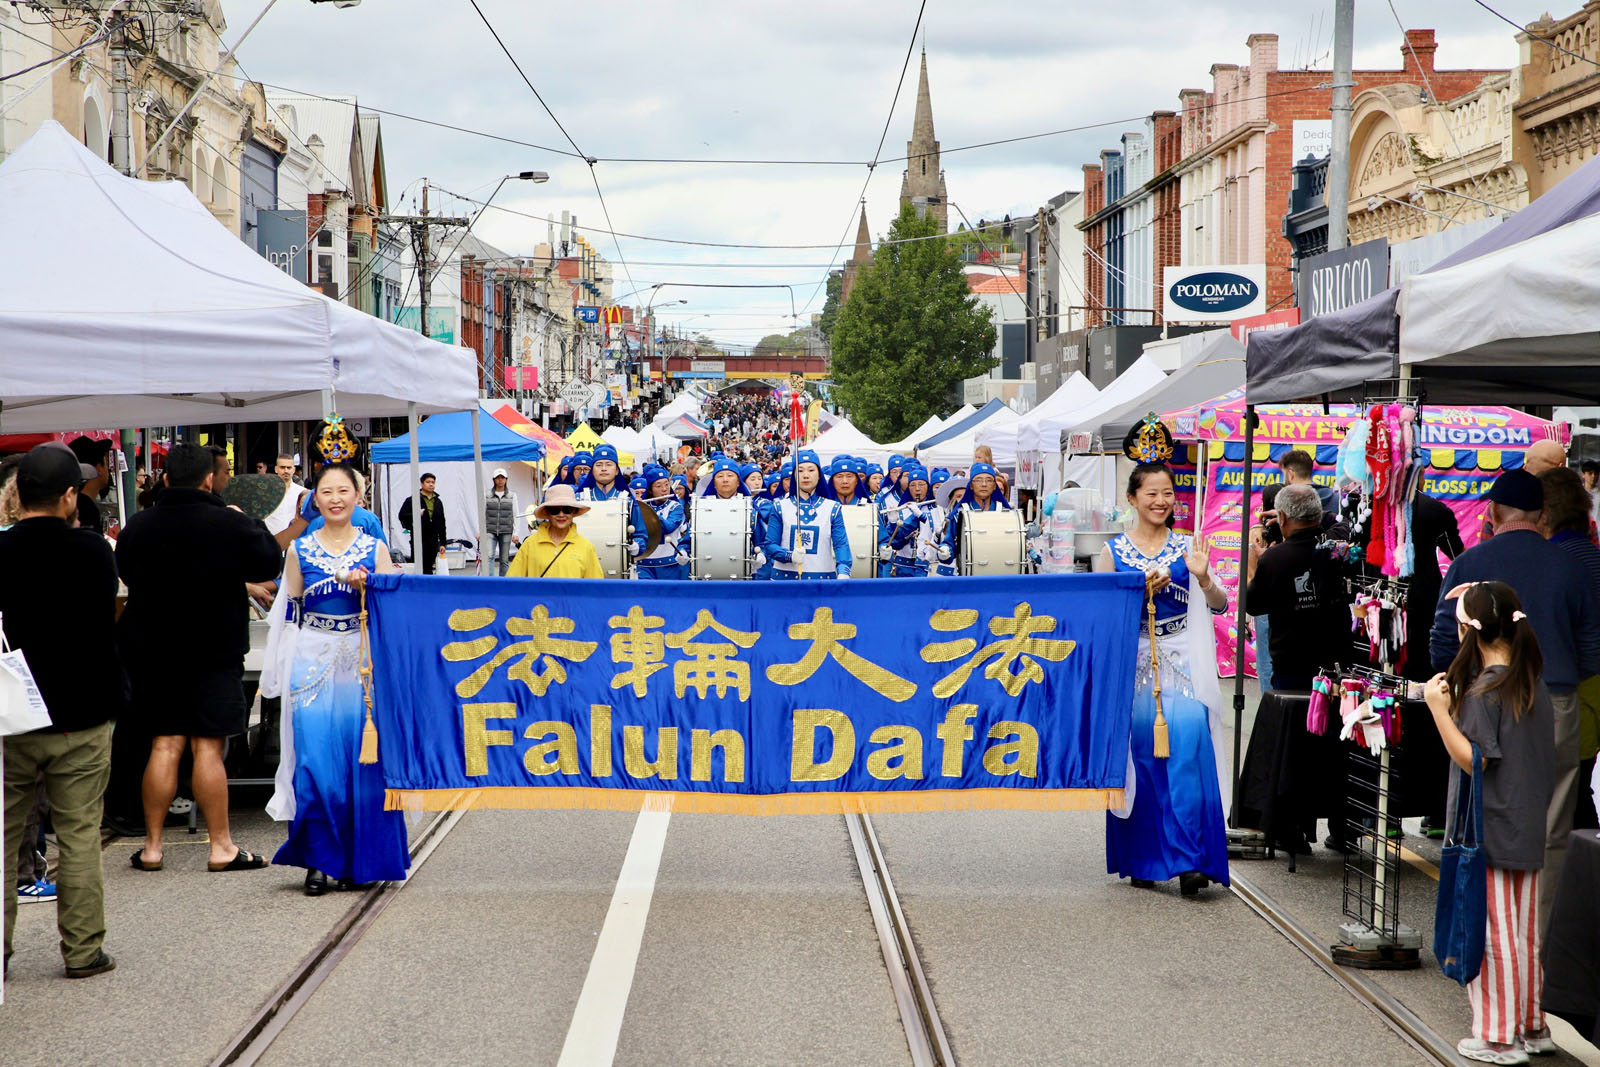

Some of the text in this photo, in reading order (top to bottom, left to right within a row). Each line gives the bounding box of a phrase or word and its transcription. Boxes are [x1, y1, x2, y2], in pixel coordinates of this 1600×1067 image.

[1303, 144, 1323, 152] and
[265, 244, 298, 277] leaf
[1176, 283, 1251, 297] POLOMAN
[1312, 257, 1372, 316] SIRICCO
[1423, 479, 1468, 494] FLOSS
[1469, 481, 1478, 494] &
[441, 601, 1076, 702] 法輪大法
[462, 702, 1040, 783] Falun Dafa
